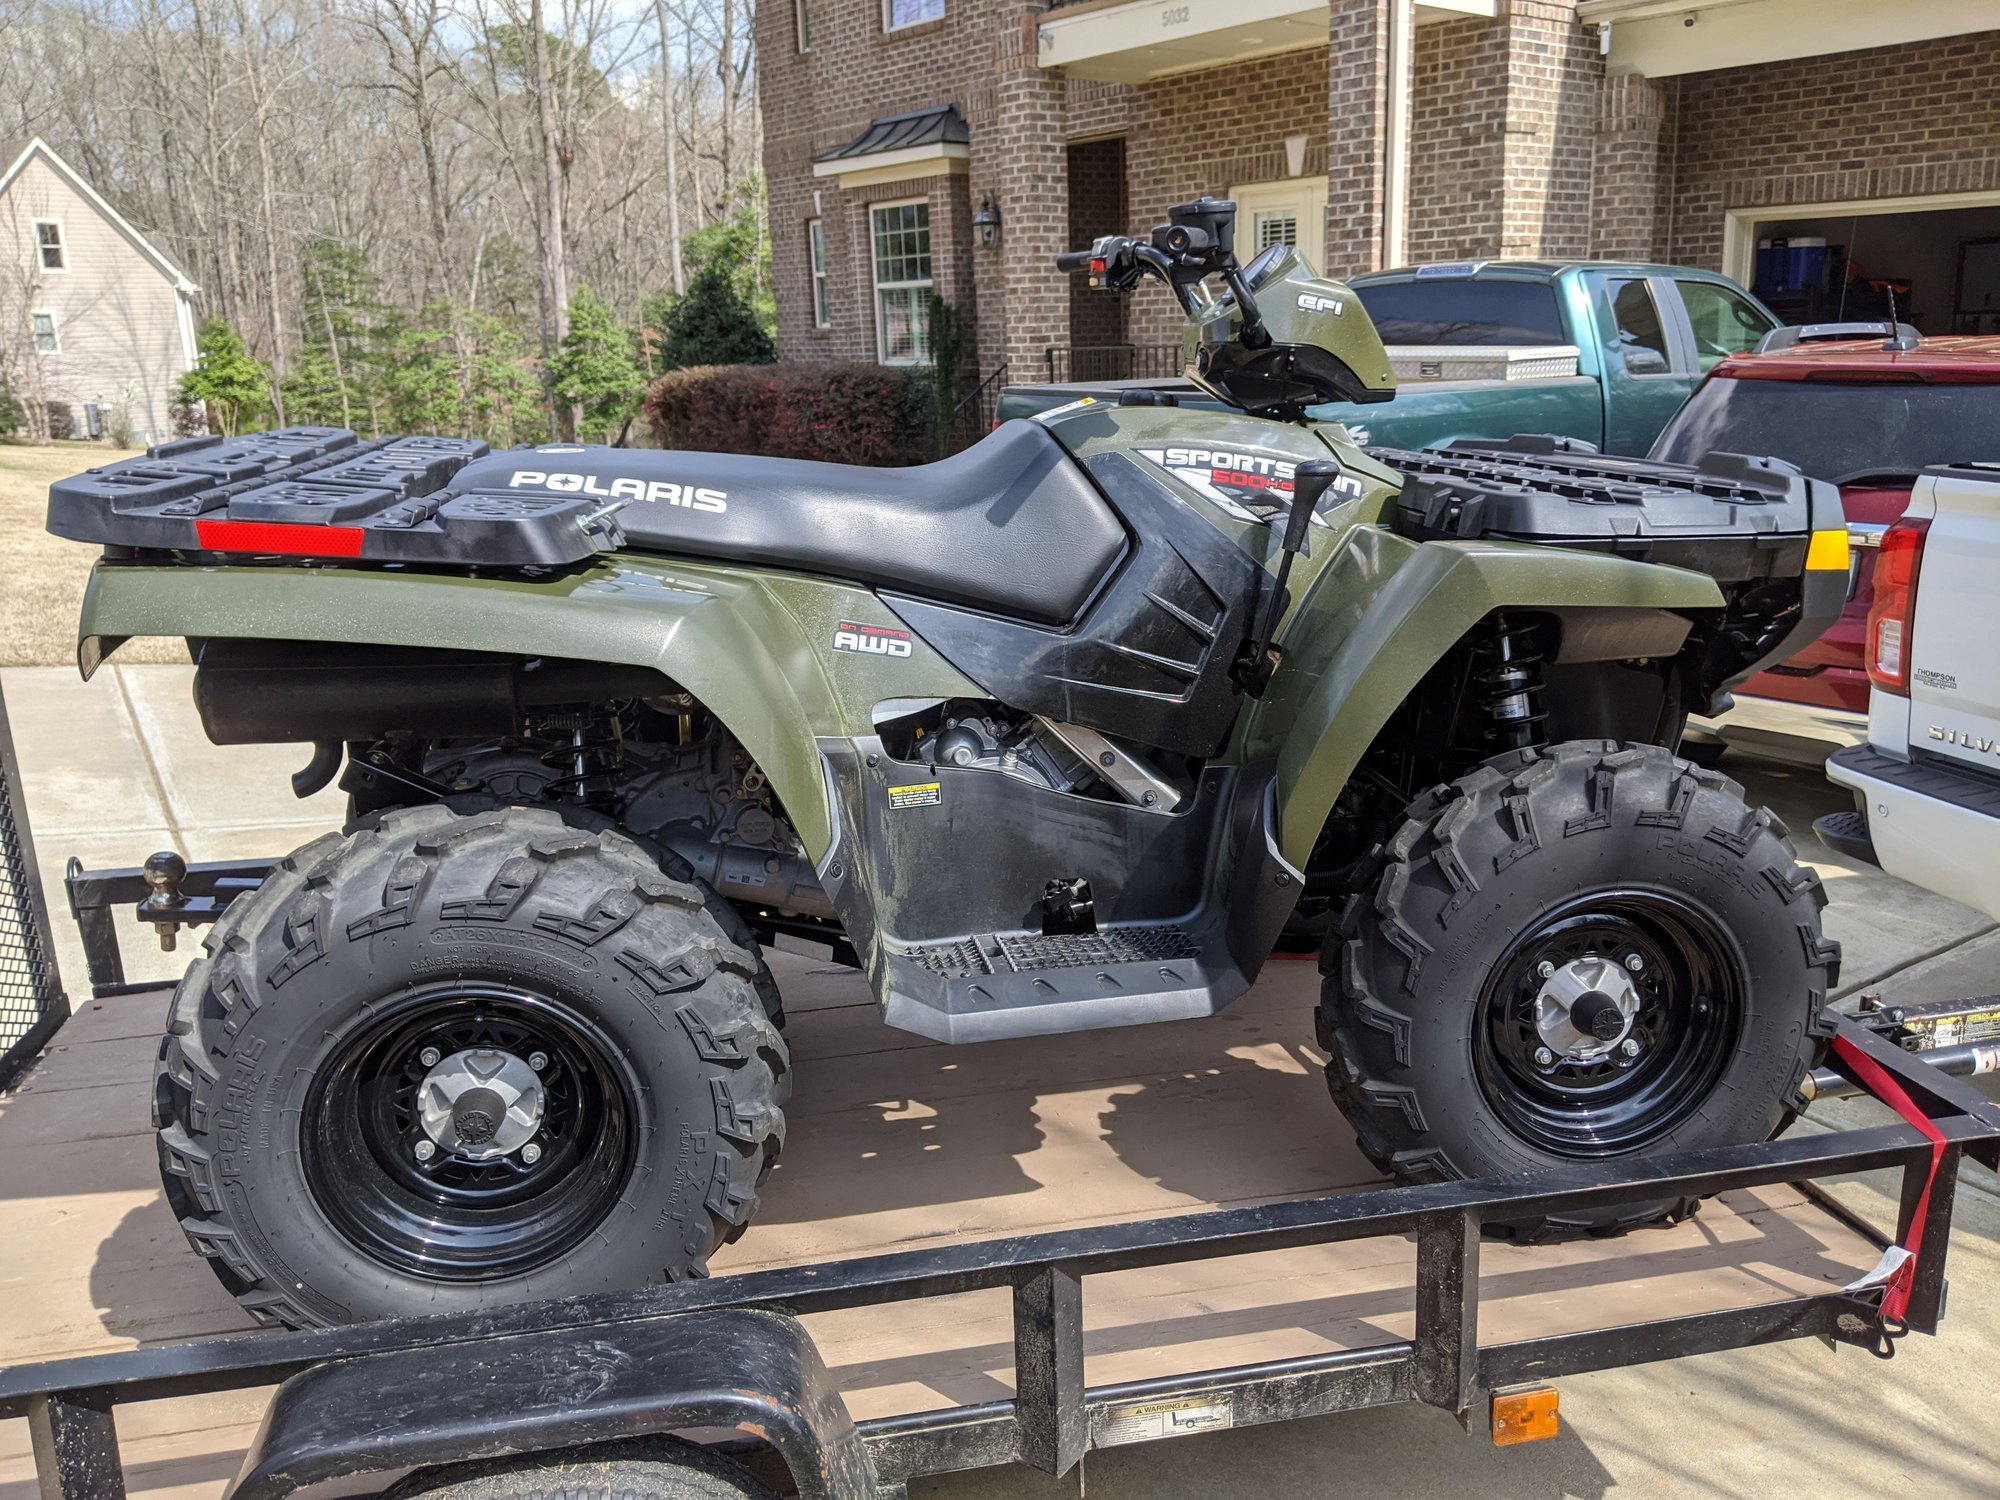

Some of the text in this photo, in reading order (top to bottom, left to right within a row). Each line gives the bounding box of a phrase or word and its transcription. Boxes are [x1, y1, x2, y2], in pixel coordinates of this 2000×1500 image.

[1297, 293, 1343, 316] EFI
[1166, 448, 1362, 497] SPORTSN
[1212, 469, 1266, 490] 500
[509, 471, 728, 514] POLARIS
[834, 631, 912, 658] AWD
[1917, 668, 1956, 682] THOMPSON
[447, 944, 465, 955] NOT
[470, 945, 489, 955] FOR
[218, 1035, 267, 1178] POLARIS
[1143, 1402, 1181, 1413] WARNING
